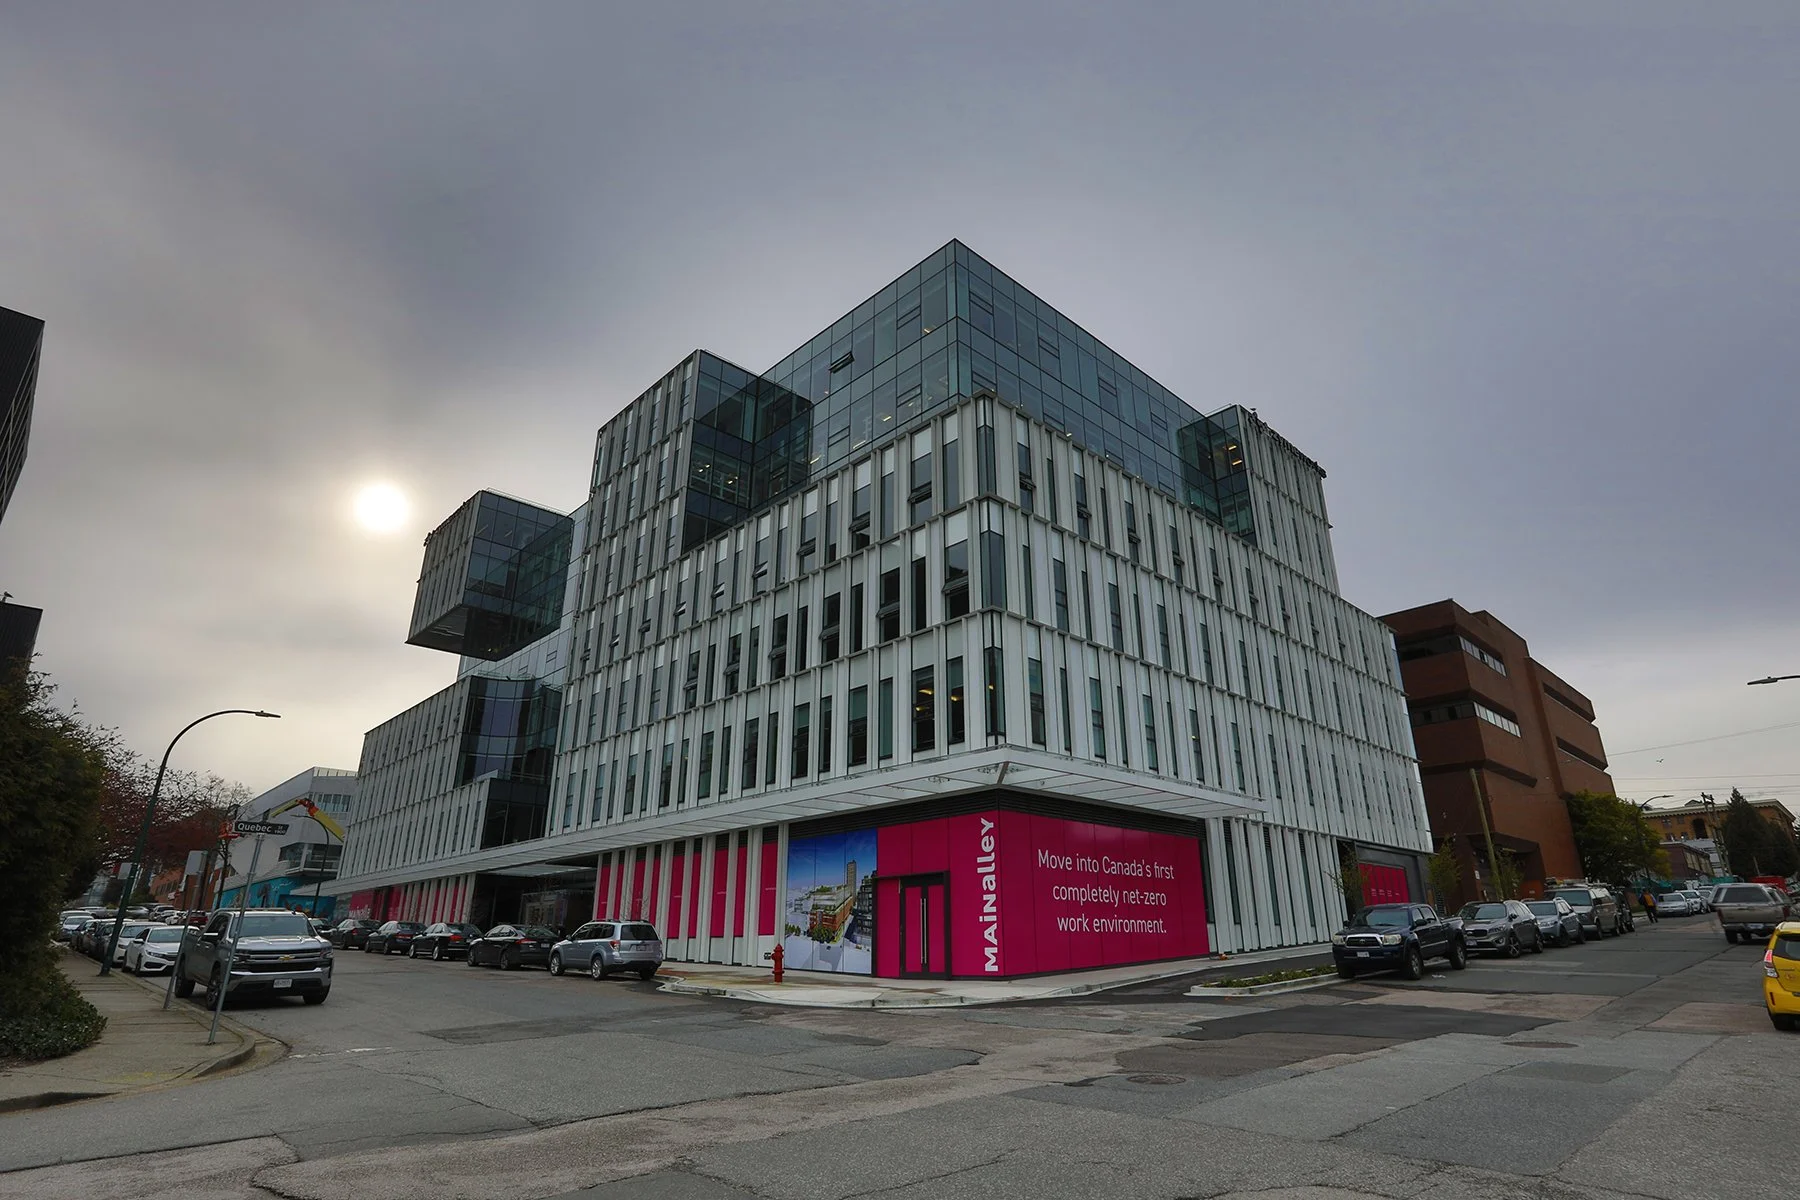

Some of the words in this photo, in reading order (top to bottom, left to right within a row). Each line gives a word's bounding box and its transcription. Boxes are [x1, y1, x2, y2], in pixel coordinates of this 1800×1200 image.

[238, 823, 271, 832] Quebec
[1038, 849, 1073, 871] Move
[1076, 853, 1099, 873] into
[1102, 856, 1152, 878] Canada's
[1154, 862, 1175, 879] first
[1053, 884, 1119, 907] completely
[1123, 887, 1167, 905] net-zero
[1057, 914, 1090, 932] work
[1093, 915, 1167, 933] environment.
